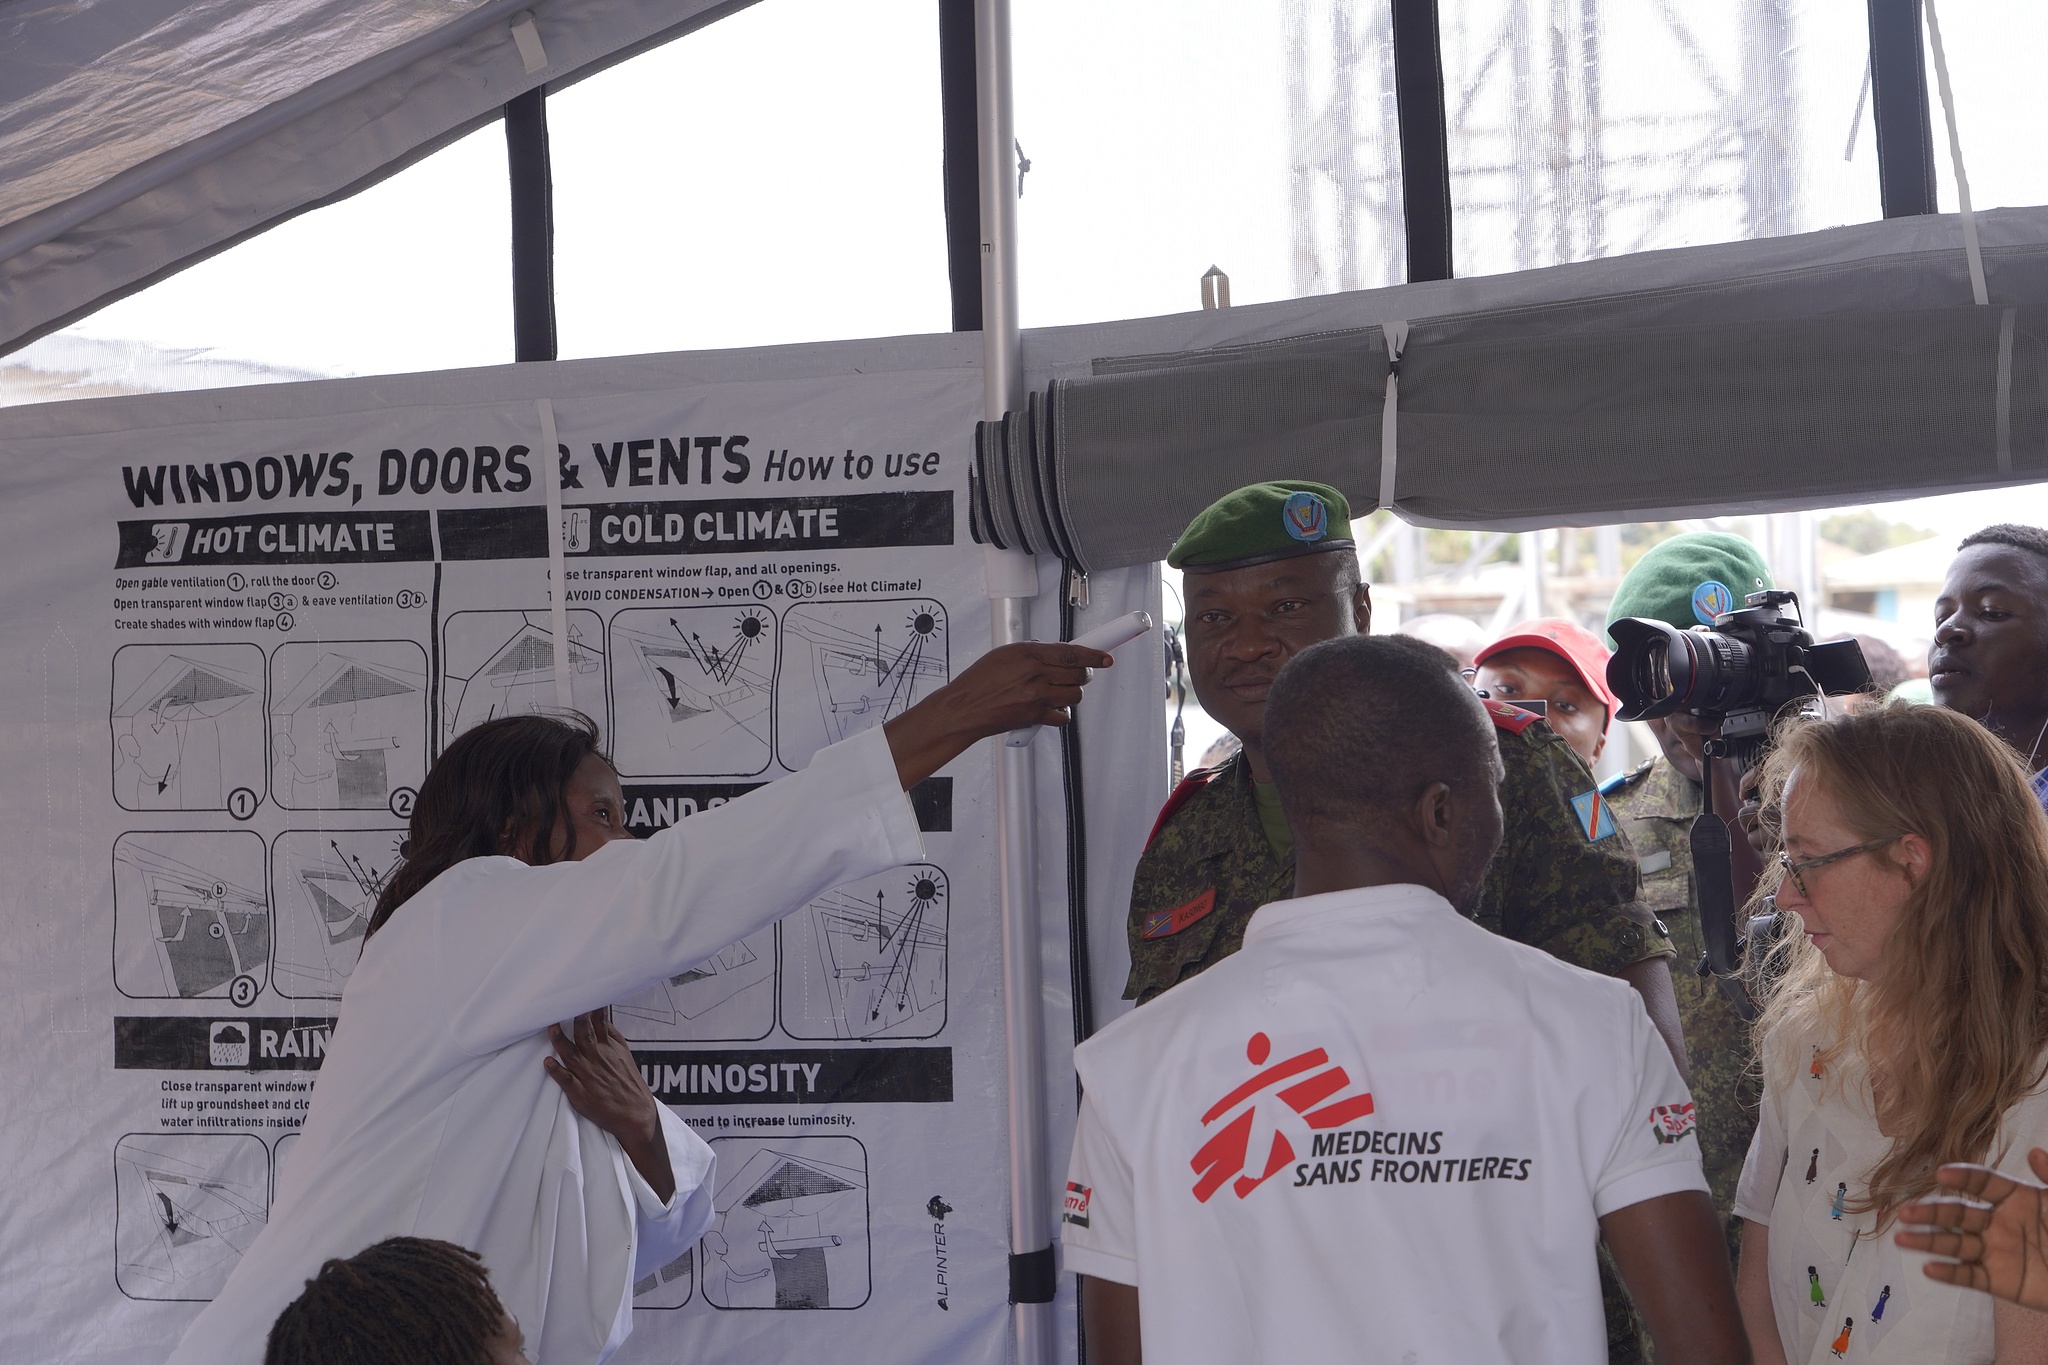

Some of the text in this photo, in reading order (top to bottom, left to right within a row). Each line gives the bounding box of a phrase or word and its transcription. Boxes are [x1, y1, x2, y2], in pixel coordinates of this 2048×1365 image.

[122, 452, 362, 507] WINDOWS,
[378, 445, 531, 496] DOORS
[593, 435, 750, 488] VENTS
[764, 449, 834, 482] How
[844, 449, 874, 480] to
[884, 451, 940, 478] use
[601, 508, 839, 543] COLD CLIMATE
[192, 523, 396, 554] HOT CLIMATE
[115, 578, 139, 590] Open
[141, 577, 168, 591] gable
[171, 576, 225, 588] ventilation
[251, 576, 270, 587] roll
[273, 576, 289, 586] the
[291, 575, 315, 586] door
[583, 567, 653, 581] transparent
[656, 567, 702, 578] window
[705, 565, 732, 577] flap,
[735, 564, 758, 575] and
[761, 563, 777, 574] all
[780, 562, 841, 576] openings.
[565, 590, 601, 601] AVOID
[605, 588, 700, 600] CONDENSATION
[718, 587, 750, 600] Open
[775, 584, 784, 595] &
[819, 582, 844, 594] (see
[847, 581, 868, 593] Hot
[871, 579, 921, 592] Climate)
[114, 598, 138, 611] Open
[141, 598, 202, 610] transparent
[204, 597, 244, 608] window
[247, 597, 267, 609] flap
[302, 596, 310, 606] &
[312, 597, 336, 606] eave
[339, 594, 393, 605] ventilation
[115, 619, 148, 629] Create
[150, 618, 186, 629] shades
[188, 618, 210, 629] with
[212, 617, 252, 628] window
[255, 617, 274, 629] flap
[623, 797, 698, 827] AND
[260, 1030, 332, 1058] RAIN
[161, 1080, 192, 1092] Close
[195, 1081, 261, 1094] transparent
[264, 1080, 307, 1092] window
[640, 1063, 822, 1093] UMINOSITY
[161, 1098, 177, 1109] lift
[181, 1101, 193, 1111] up
[197, 1098, 269, 1111] groundsheet
[272, 1099, 291, 1109] and
[161, 1116, 300, 1127] water infiltrations inside
[682, 1114, 855, 1128] ened to increase luminosity.
[1311, 1130, 1443, 1157] MEDECINS
[1294, 1156, 1532, 1187] SANS FRONTIERES
[934, 1222, 948, 1311] ALPINTER
